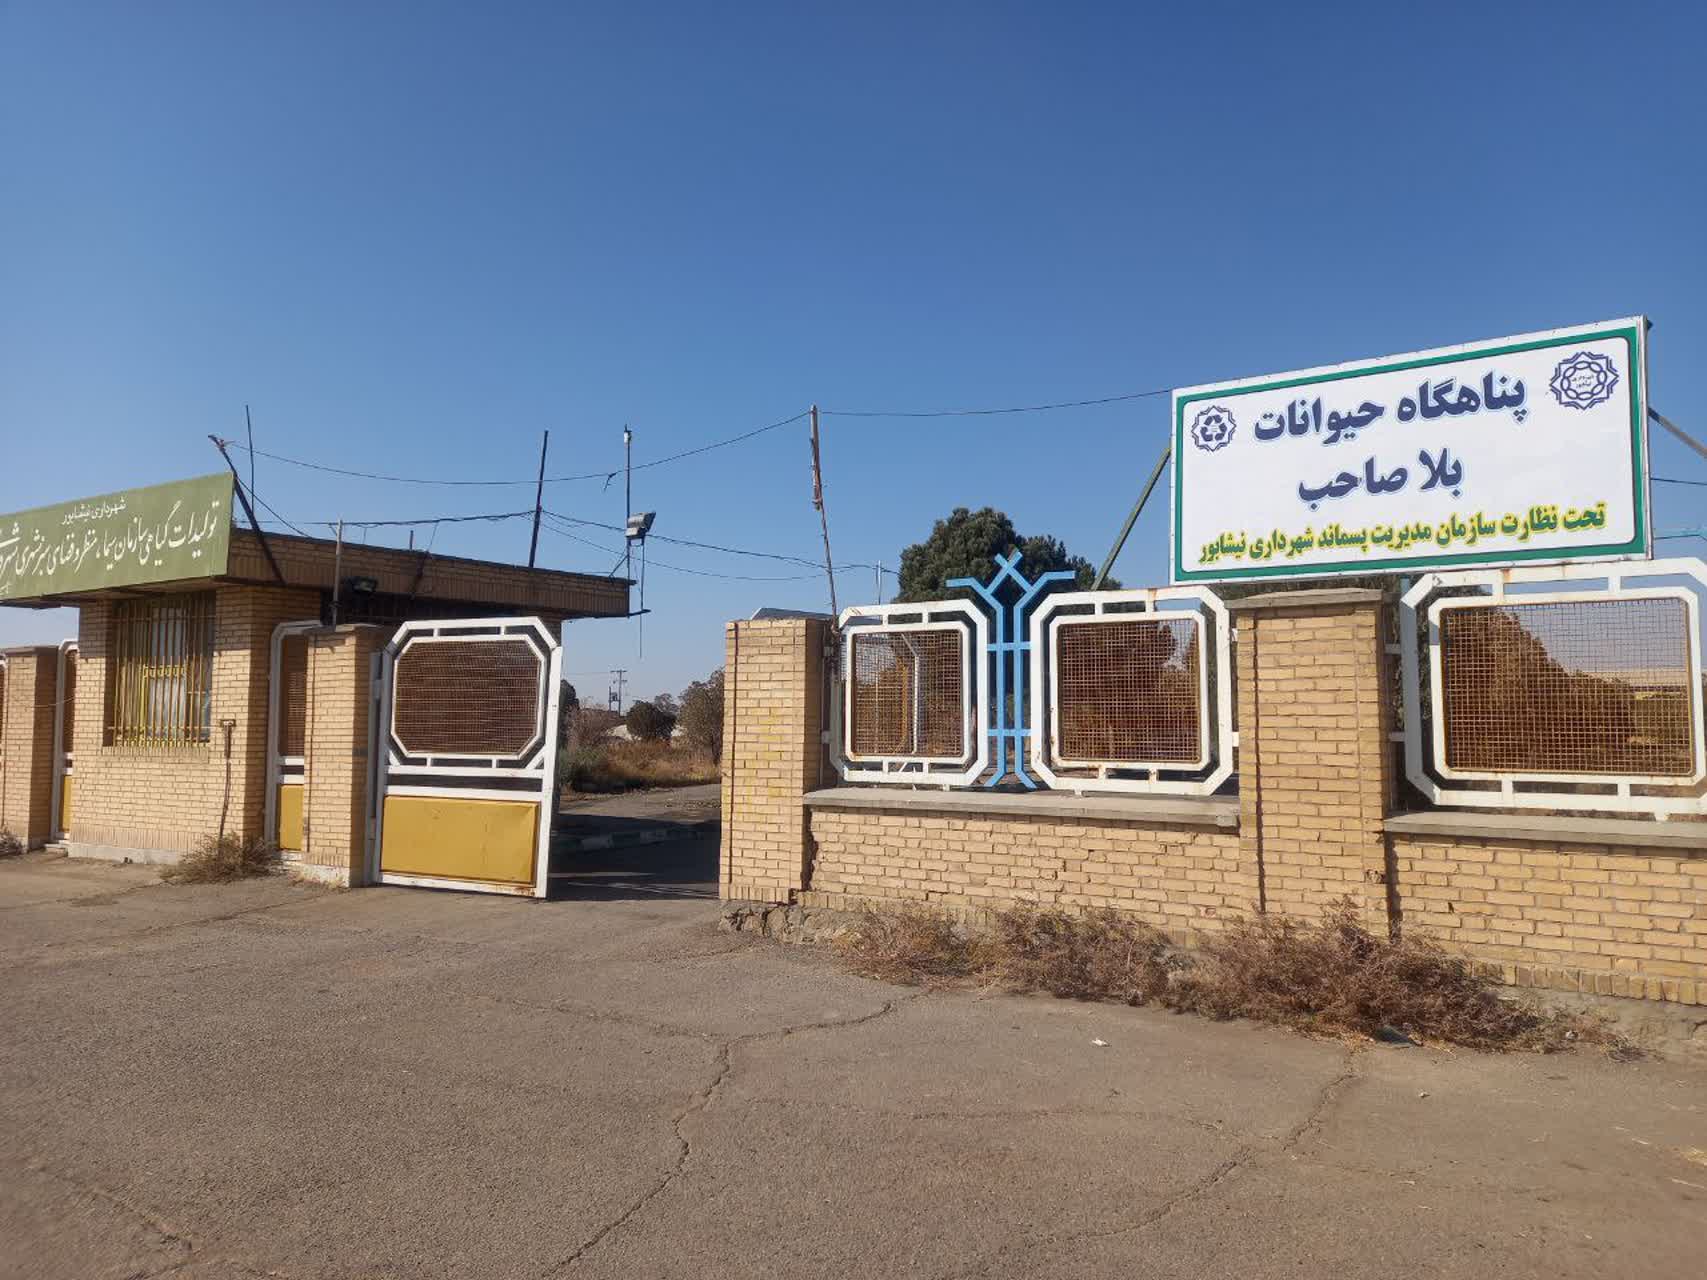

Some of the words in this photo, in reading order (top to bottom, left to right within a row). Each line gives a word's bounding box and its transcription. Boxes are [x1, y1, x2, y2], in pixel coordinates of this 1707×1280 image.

[1396, 370, 1528, 423] پناهگاه
[1253, 395, 1386, 445] حیوانات
[1298, 455, 1409, 511] صاحب
[1418, 446, 1464, 498] بلا
[91, 496, 127, 519] شهرداری
[1500, 503, 1559, 542] نظارت
[1562, 502, 1607, 531] تحت
[168, 500, 220, 559] تولیدات
[1250, 526, 1315, 560] شهرداری
[1317, 523, 1368, 553] پسماند
[1372, 521, 1433, 550] مدیریت
[1436, 511, 1498, 546] سازمان
[1198, 532, 1247, 565] نیشابور
